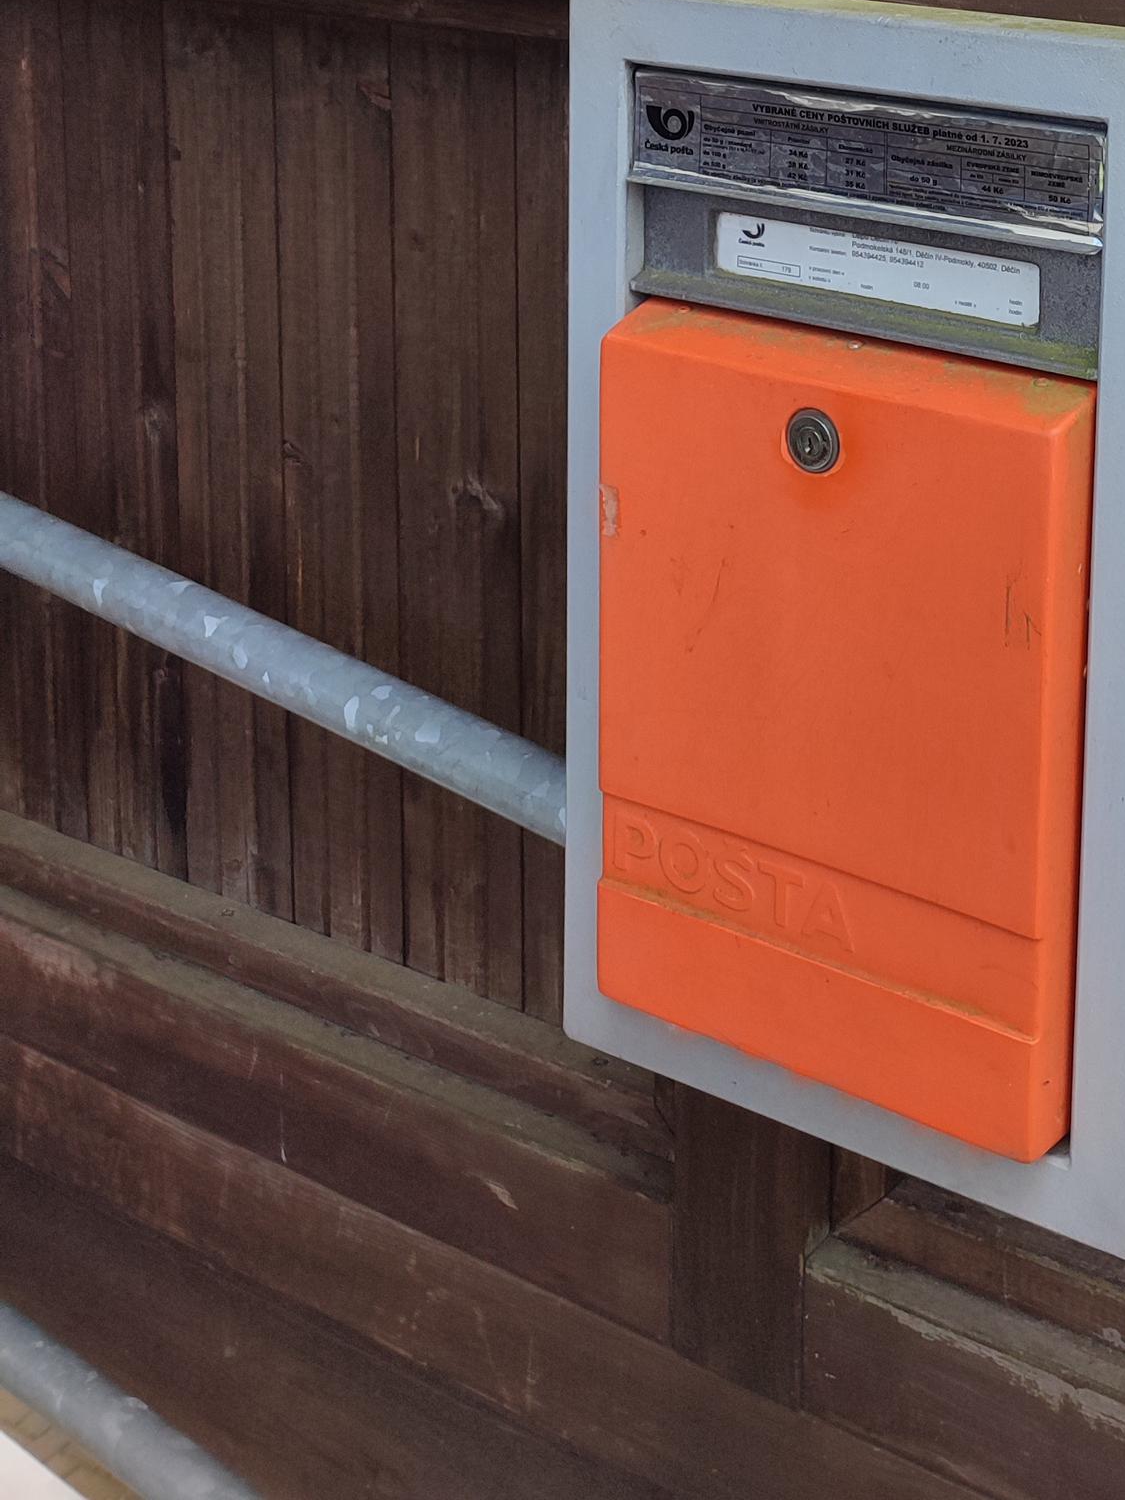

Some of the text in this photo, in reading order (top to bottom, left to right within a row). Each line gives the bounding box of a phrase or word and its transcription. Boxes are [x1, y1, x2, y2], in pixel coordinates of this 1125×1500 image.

[752, 103, 1029, 148] VYBRANÉ CENY POŠTOVNÍCH SLUŽEB platné od 1. 7. 2023
[801, 122, 830, 134] ZÁSILKY
[644, 139, 669, 151] Česká
[670, 145, 694, 156] pošta
[946, 144, 1027, 162] MEZINÁRODNÍ ZÁSILKY
[909, 175, 920, 183] do
[993, 185, 1005, 195] Kč
[1060, 196, 1072, 205] Kč
[915, 251, 934, 261] Děčín
[1001, 264, 1021, 275] Děčín
[613, 811, 856, 954] POŠTA
